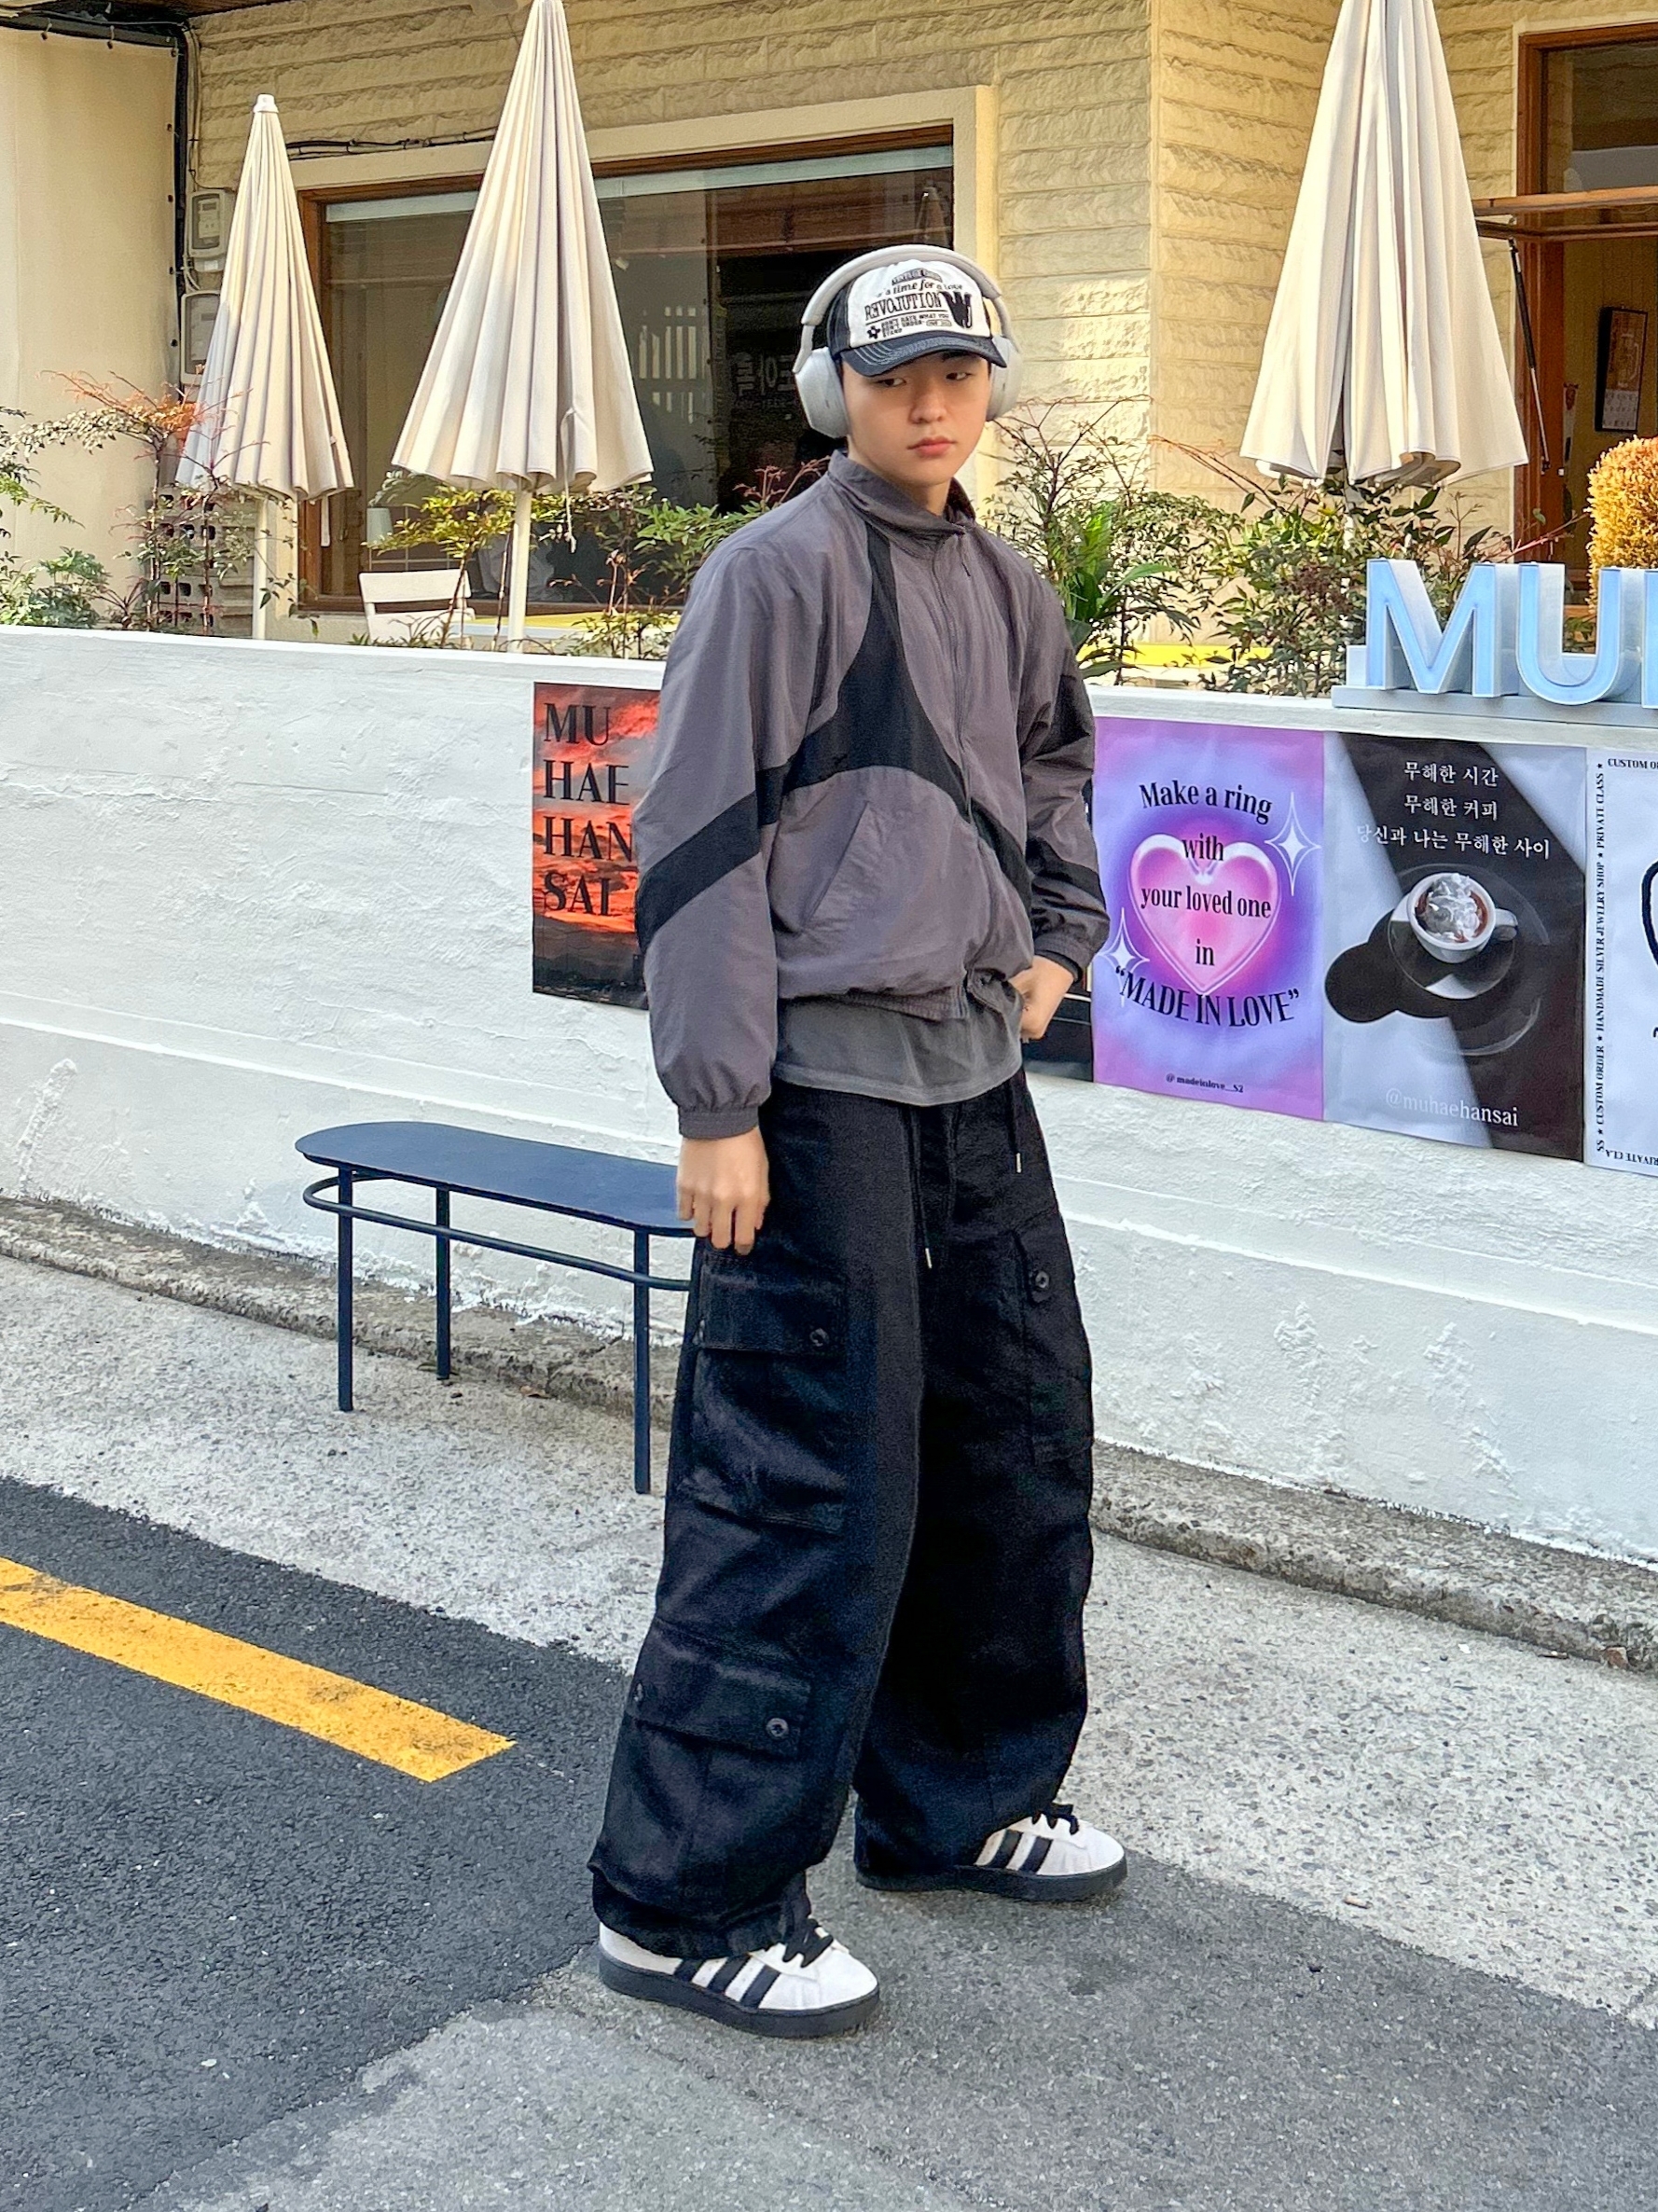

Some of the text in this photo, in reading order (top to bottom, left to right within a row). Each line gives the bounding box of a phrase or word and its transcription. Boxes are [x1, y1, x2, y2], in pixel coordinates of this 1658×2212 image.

[893, 282, 918, 295] time
[919, 279, 934, 291] for
[1366, 558, 1658, 709] MU
[543, 702, 611, 746] MU
[1403, 761, 1499, 787] 무해한 시간
[1607, 757, 1648, 769] CUSTOM
[543, 759, 630, 806] HAE
[1596, 772, 1605, 804] CLASS
[1139, 780, 1273, 824] Make a ring
[1403, 795, 1498, 822] 무해한 커피
[543, 815, 634, 864] HAN
[1357, 823, 1551, 861] 당신과 나는 무해한 사이
[1596, 806, 1605, 849] PRIVATE
[1181, 833, 1224, 862] with
[1596, 861, 1605, 889] SHOP
[543, 871, 613, 917] SAI
[1140, 885, 1272, 919] your loved one
[1596, 890, 1605, 936] JEWELRY
[1195, 938, 1215, 966] in
[1596, 937, 1605, 973] SILVER
[1195, 993, 1221, 1025] IN
[1596, 975, 1605, 1031] HANDMADE
[1596, 1045, 1605, 1081] ORDER
[1385, 1086, 1519, 1127] @muhaehansai
[1596, 1082, 1605, 1126] CUSTOM
